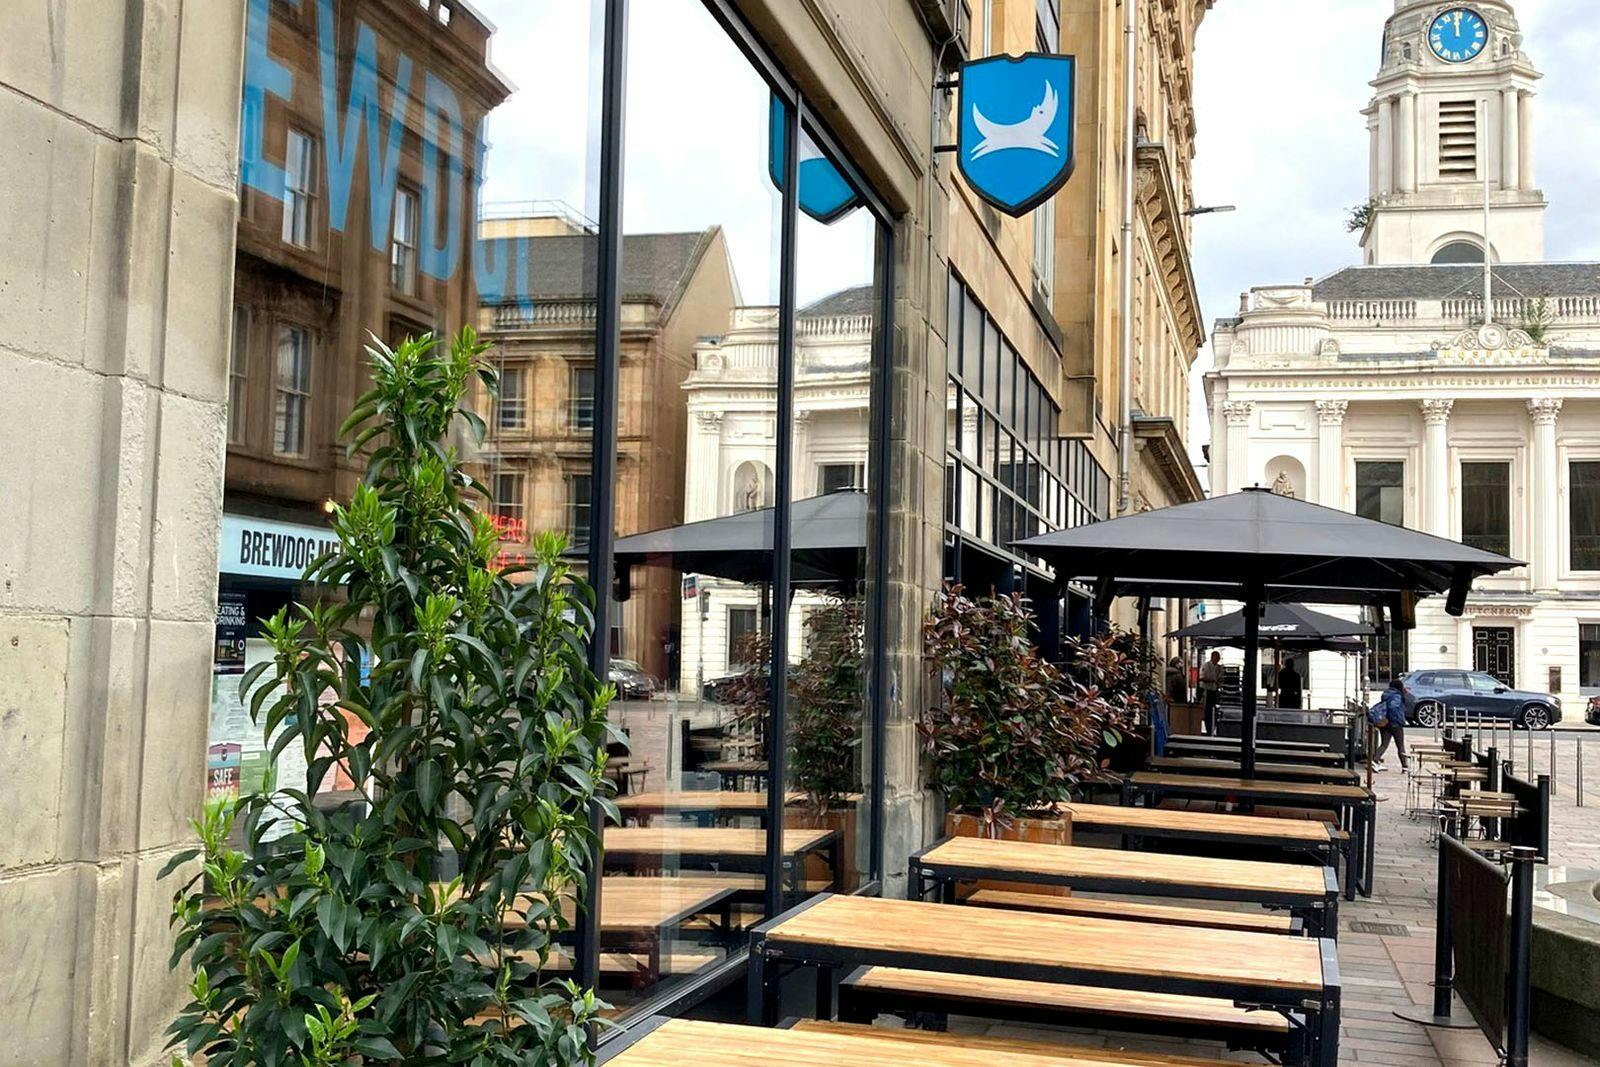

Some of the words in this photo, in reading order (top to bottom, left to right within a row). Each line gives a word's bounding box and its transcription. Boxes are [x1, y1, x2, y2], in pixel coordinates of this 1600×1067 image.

[1246, 380, 1298, 388] FOUNDED
[240, 529, 315, 570] BREWDOG
[216, 605, 240, 616] EATING
[215, 615, 246, 626] DRINKING
[213, 768, 233, 786] SAFE
